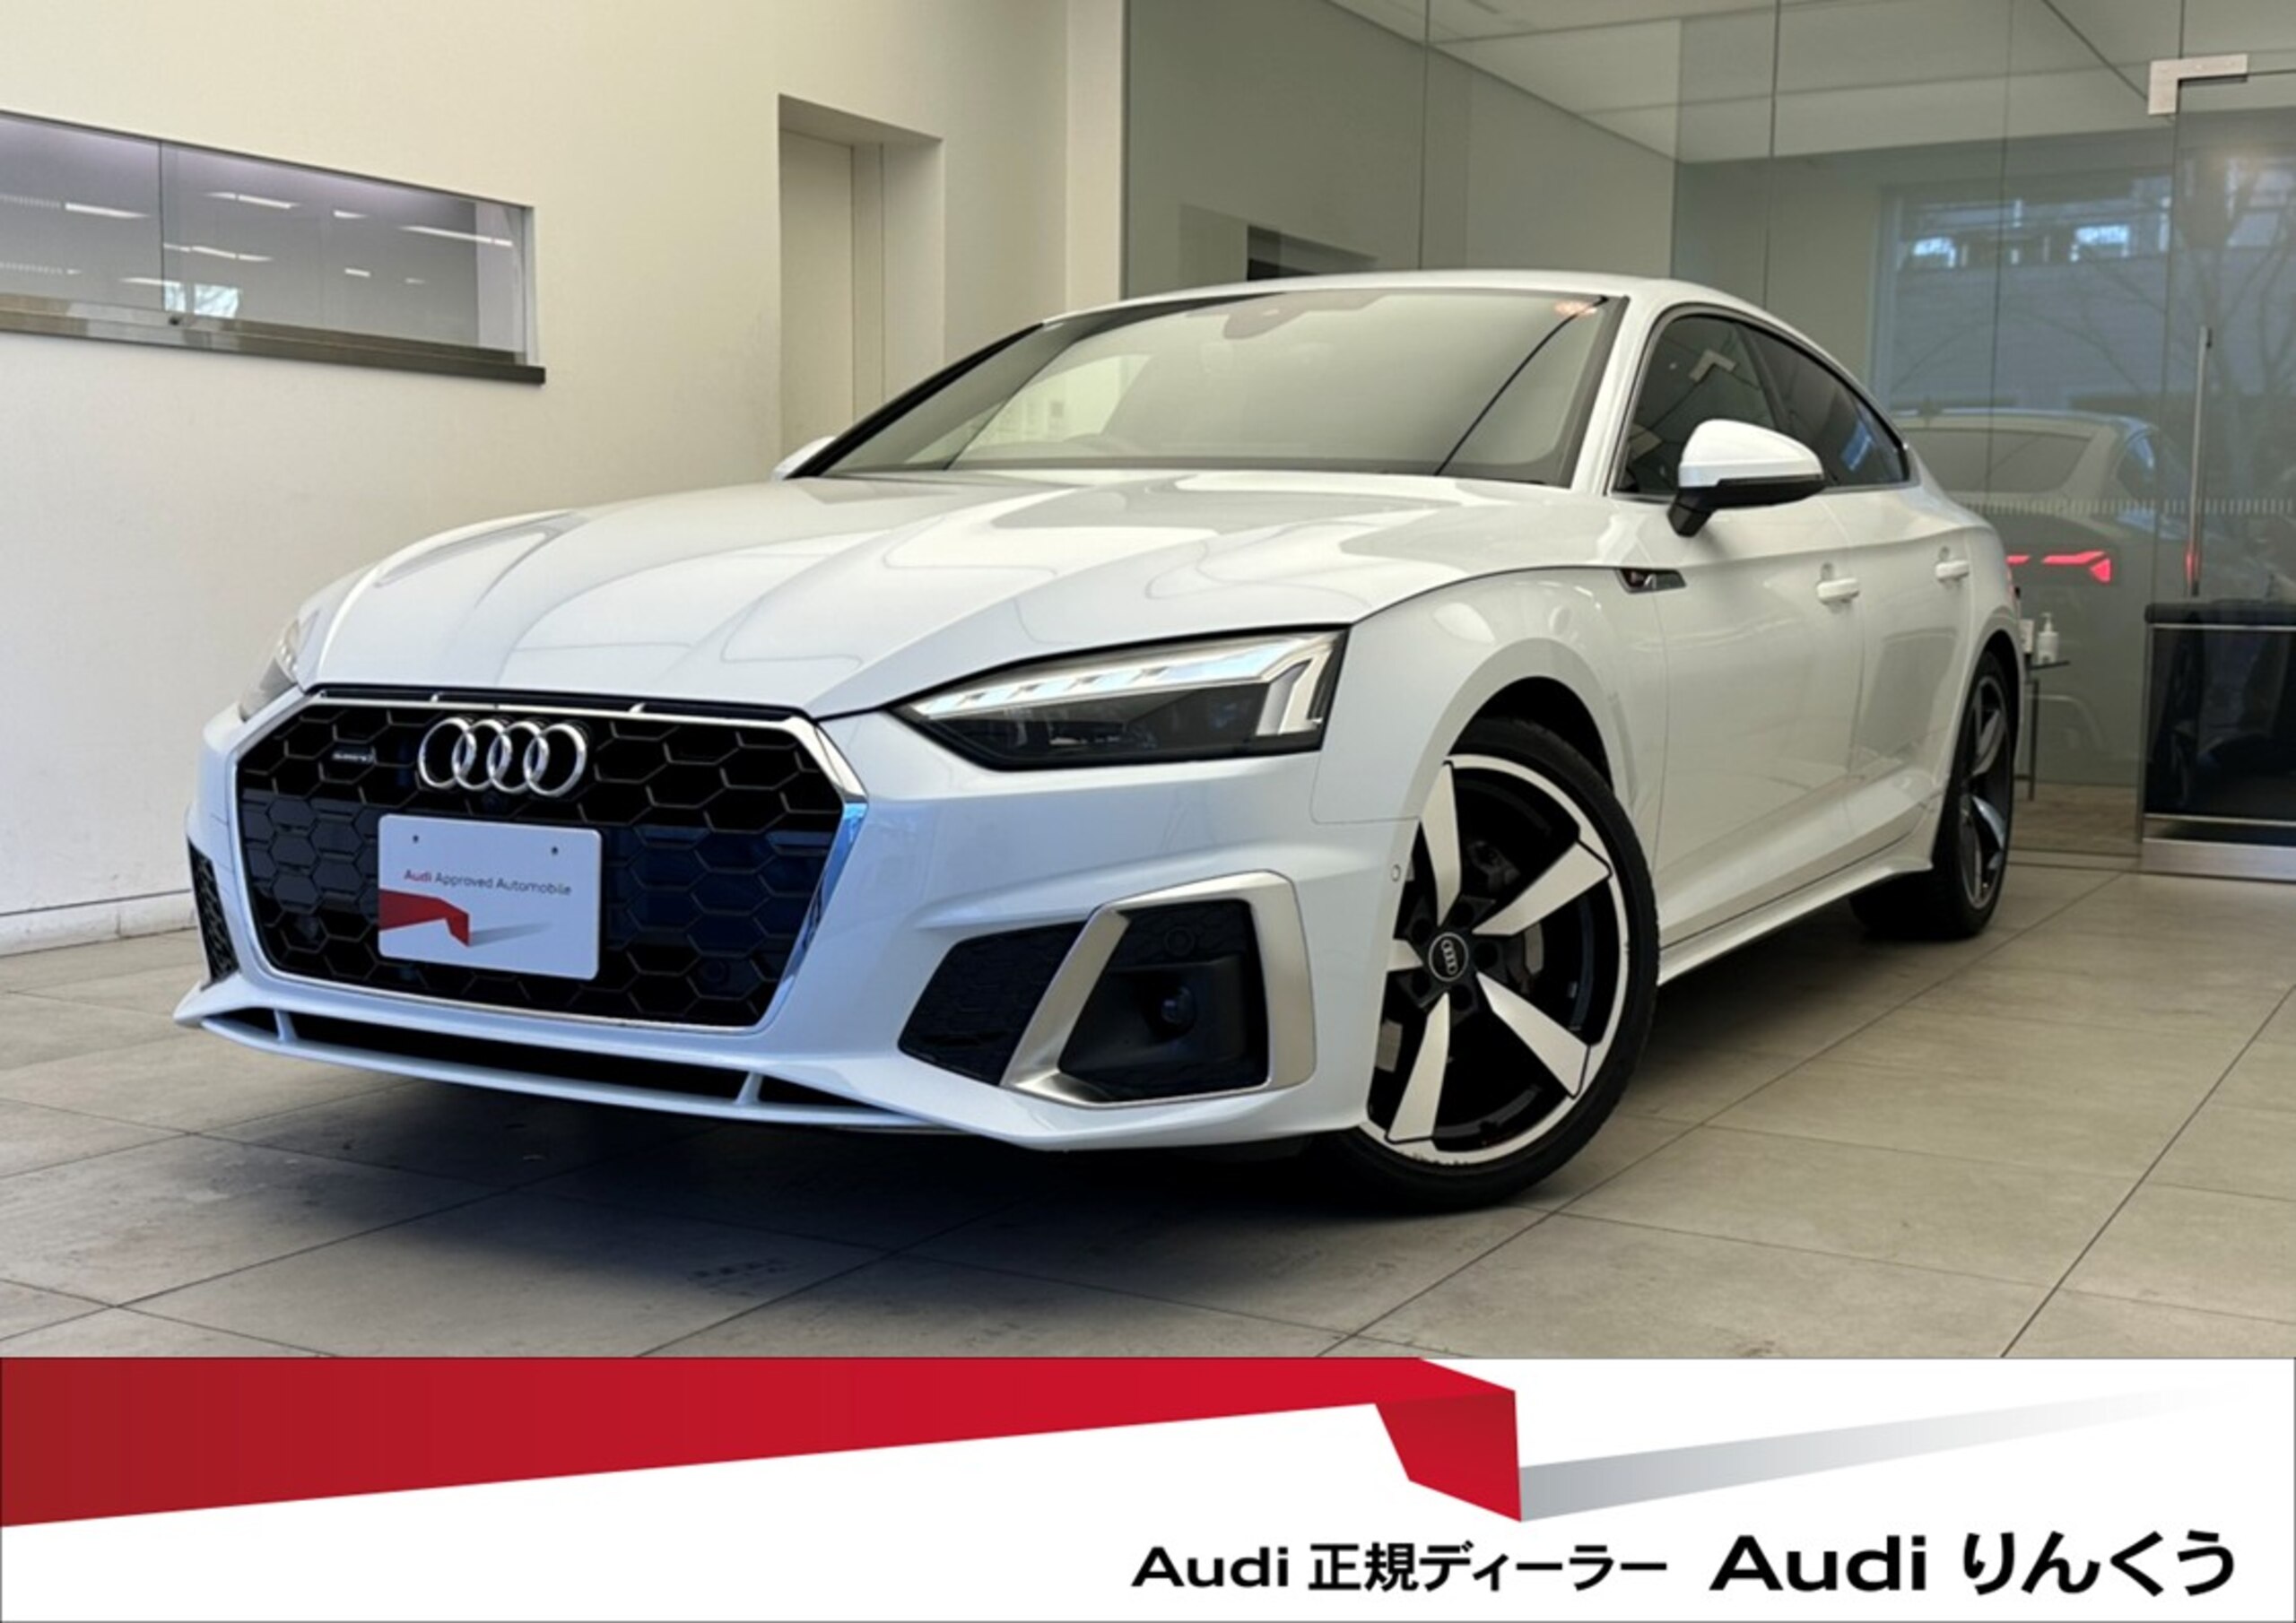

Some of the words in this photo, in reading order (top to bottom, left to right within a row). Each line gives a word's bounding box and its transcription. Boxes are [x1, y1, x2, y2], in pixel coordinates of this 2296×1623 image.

[404, 869, 432, 882] Audi
[435, 872, 493, 889] Approved
[496, 878, 572, 896] Automobile
